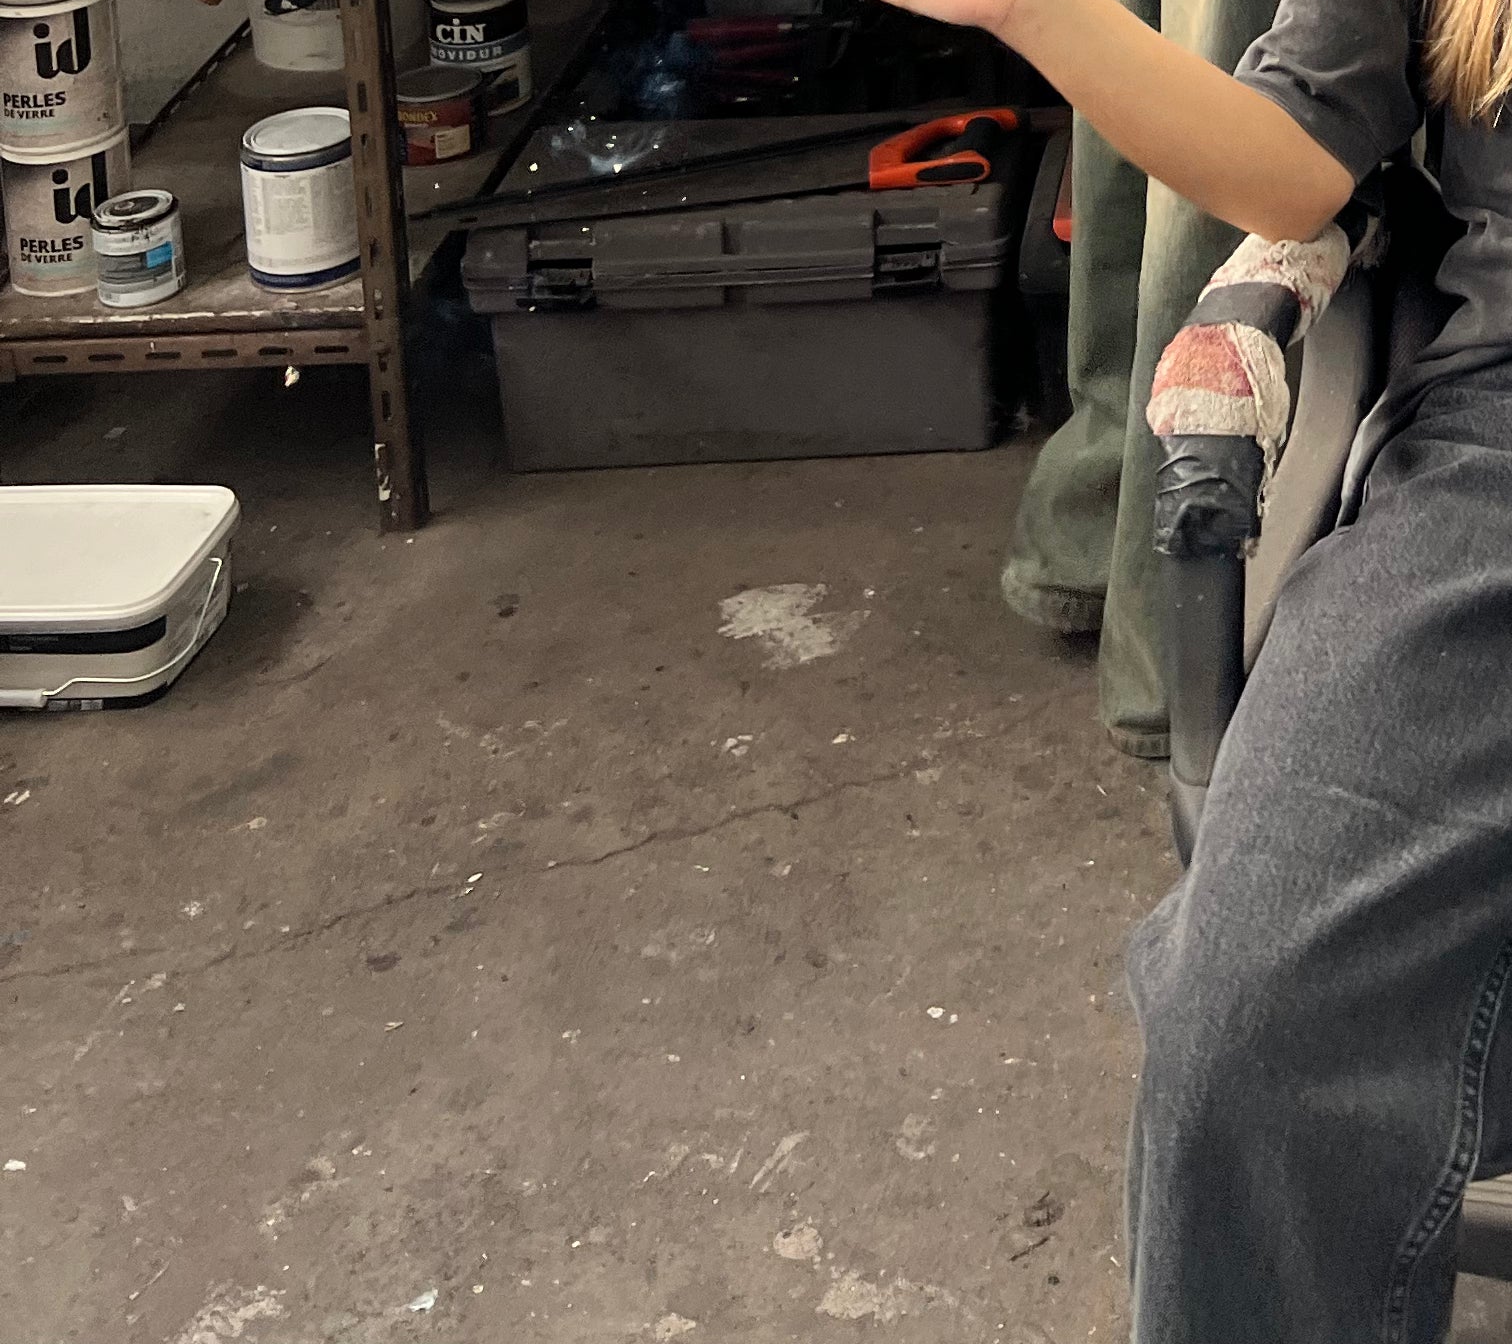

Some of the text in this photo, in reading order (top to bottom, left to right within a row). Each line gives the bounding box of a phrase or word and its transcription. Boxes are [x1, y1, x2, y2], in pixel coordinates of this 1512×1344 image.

[33, 6, 92, 80] id
[3, 91, 66, 109] PERLES
[4, 109, 55, 120] DE VERRE
[19, 235, 84, 254] PERLES
[20, 253, 73, 264] DE VERRE
